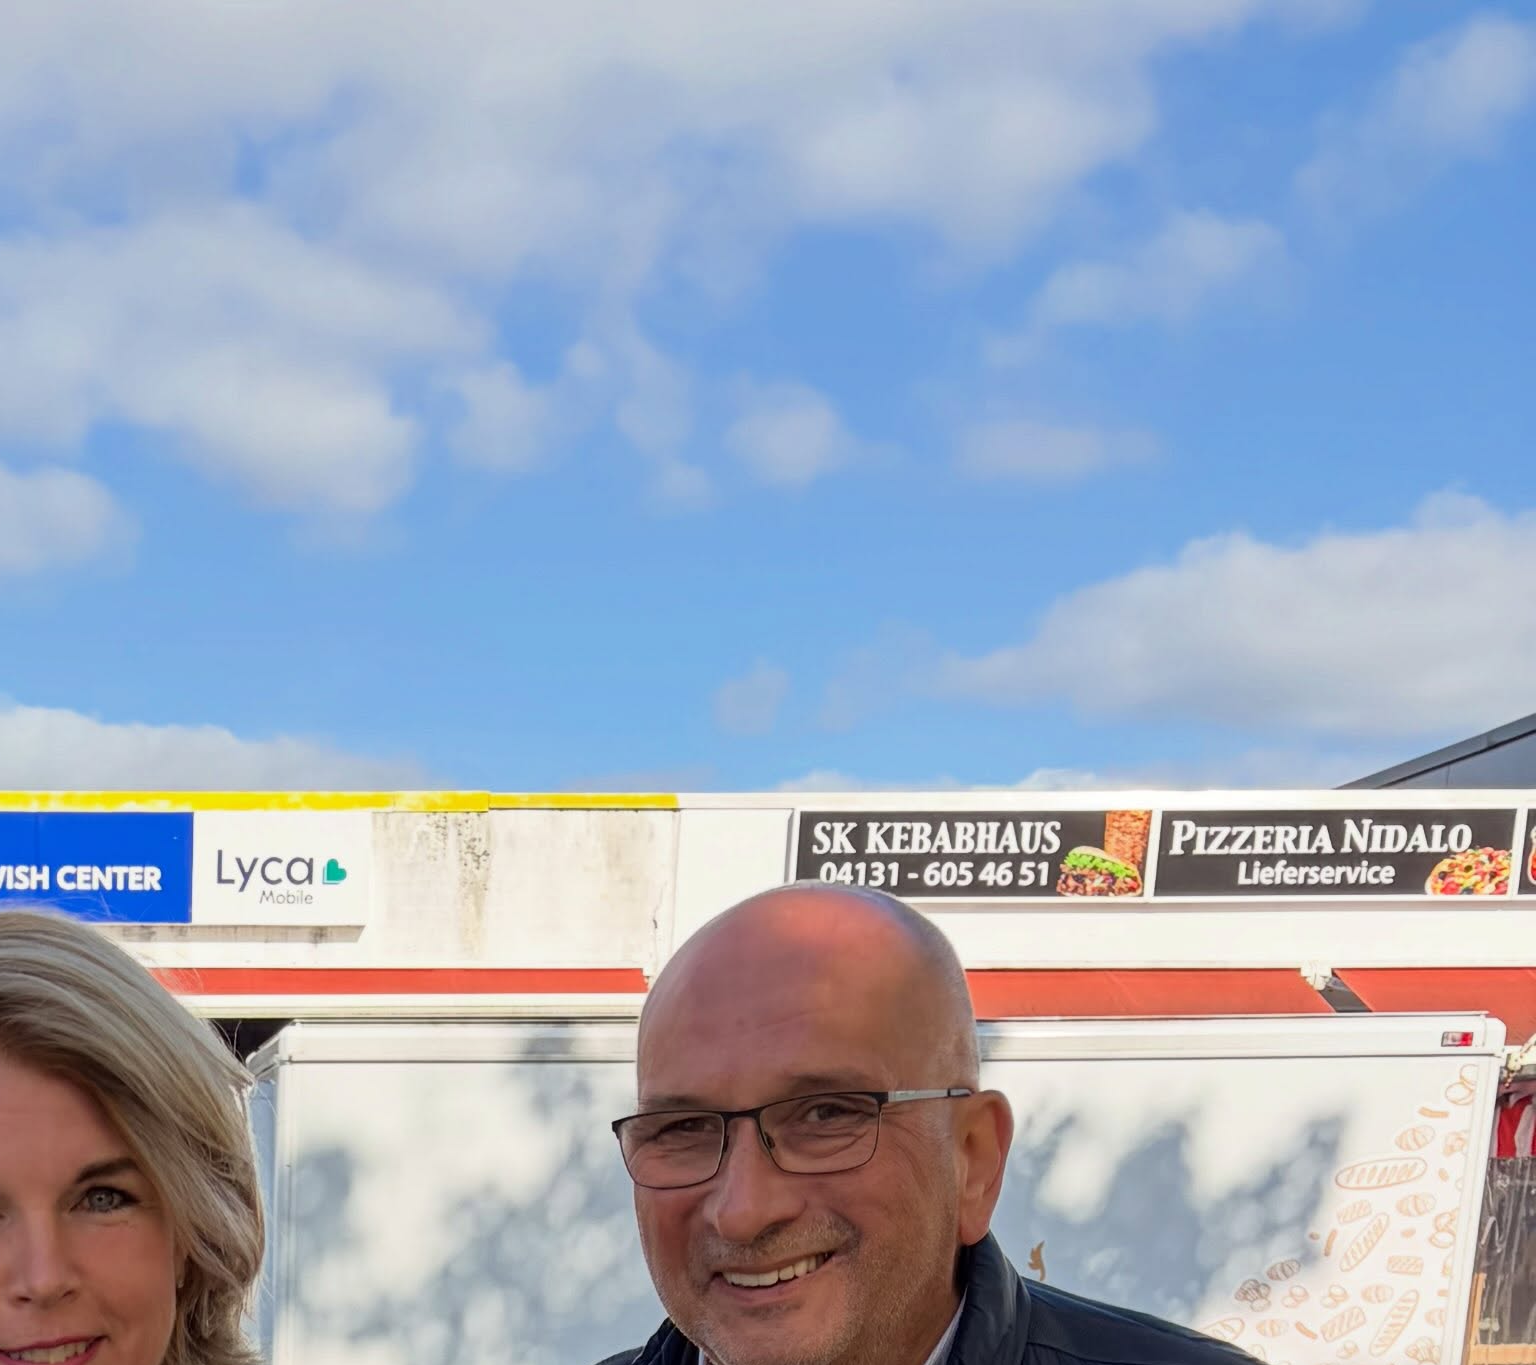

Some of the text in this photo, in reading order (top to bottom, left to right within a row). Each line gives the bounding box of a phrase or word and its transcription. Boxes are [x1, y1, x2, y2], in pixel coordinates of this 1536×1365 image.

[812, 821, 1061, 855] SK KEBABHAUS
[1169, 818, 1472, 855] PIZZERIA NIDALO
[57, 865, 163, 892] CENTER
[216, 849, 314, 892] Lyca
[820, 861, 900, 887] 04131
[923, 861, 975, 887] 605
[979, 861, 1014, 887] 46
[1018, 861, 1050, 887] 51
[1238, 860, 1396, 886] Lieferservice
[259, 889, 313, 905] Mobile
